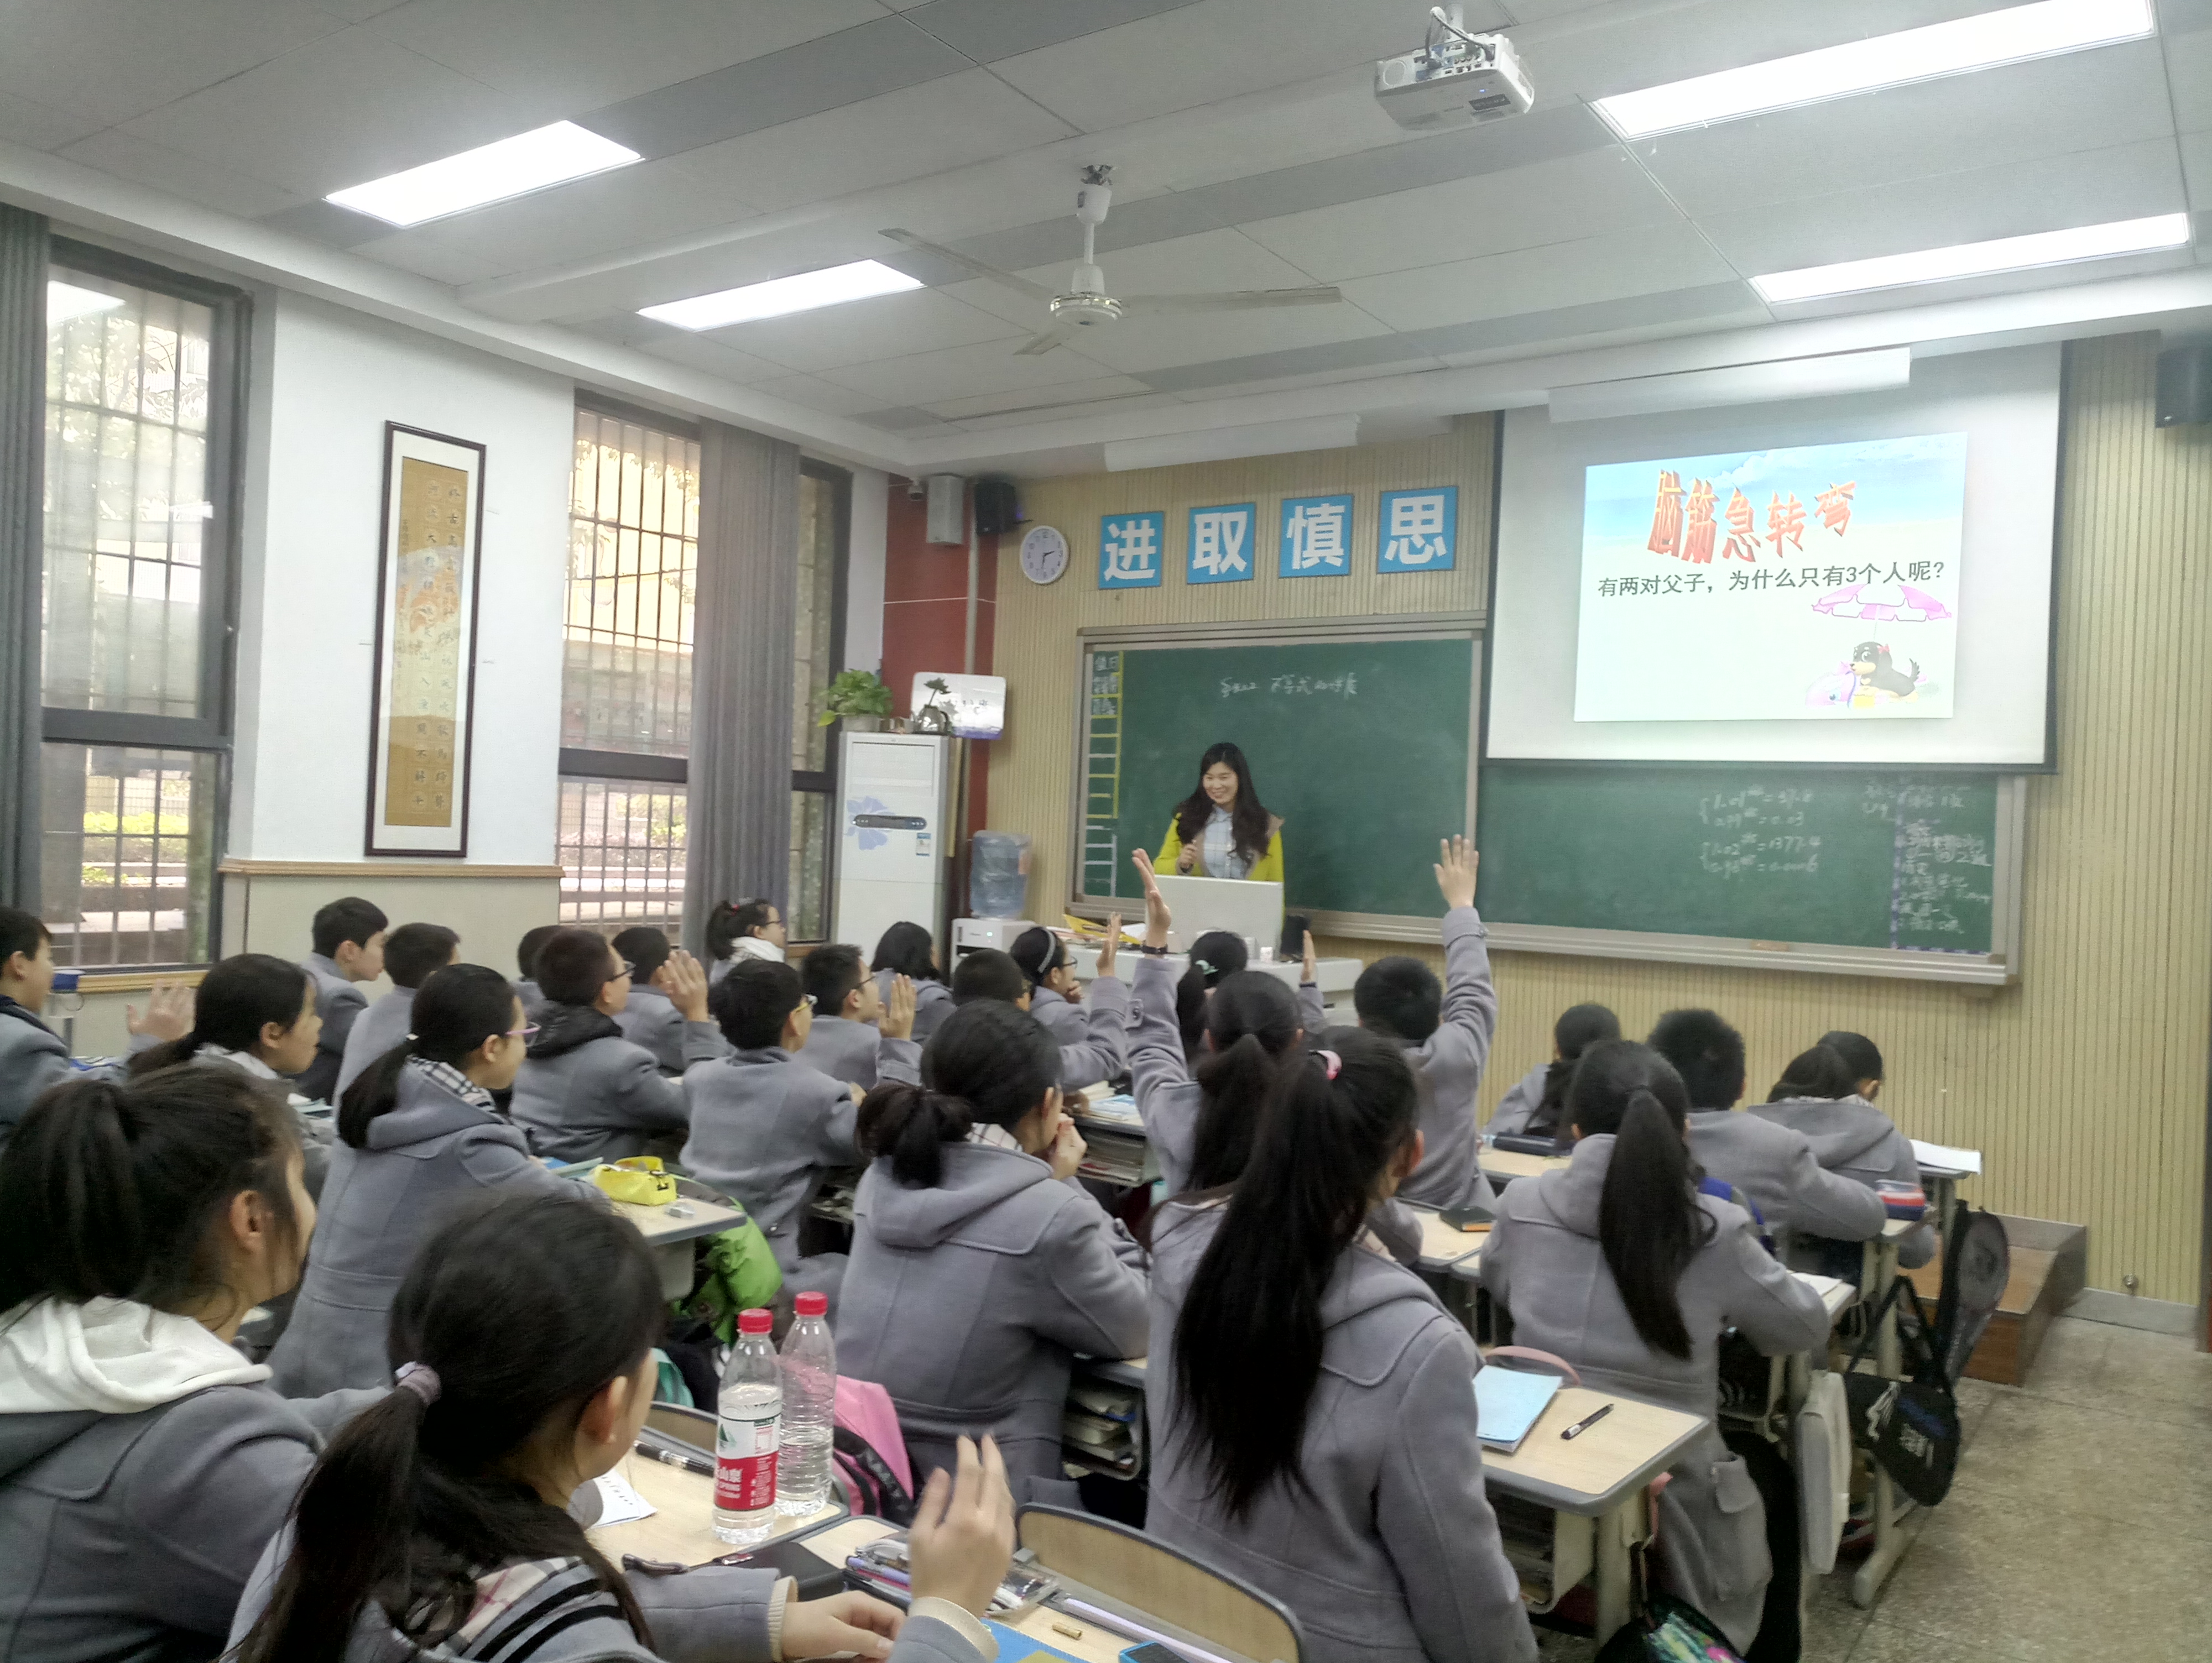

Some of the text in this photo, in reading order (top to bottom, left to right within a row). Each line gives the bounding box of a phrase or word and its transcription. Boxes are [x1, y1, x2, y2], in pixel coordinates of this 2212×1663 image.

[1647, 468, 1857, 564] 脑筋急转弯
[1598, 561, 1945, 597] 有两对父子，为什么只有3个人呢？
